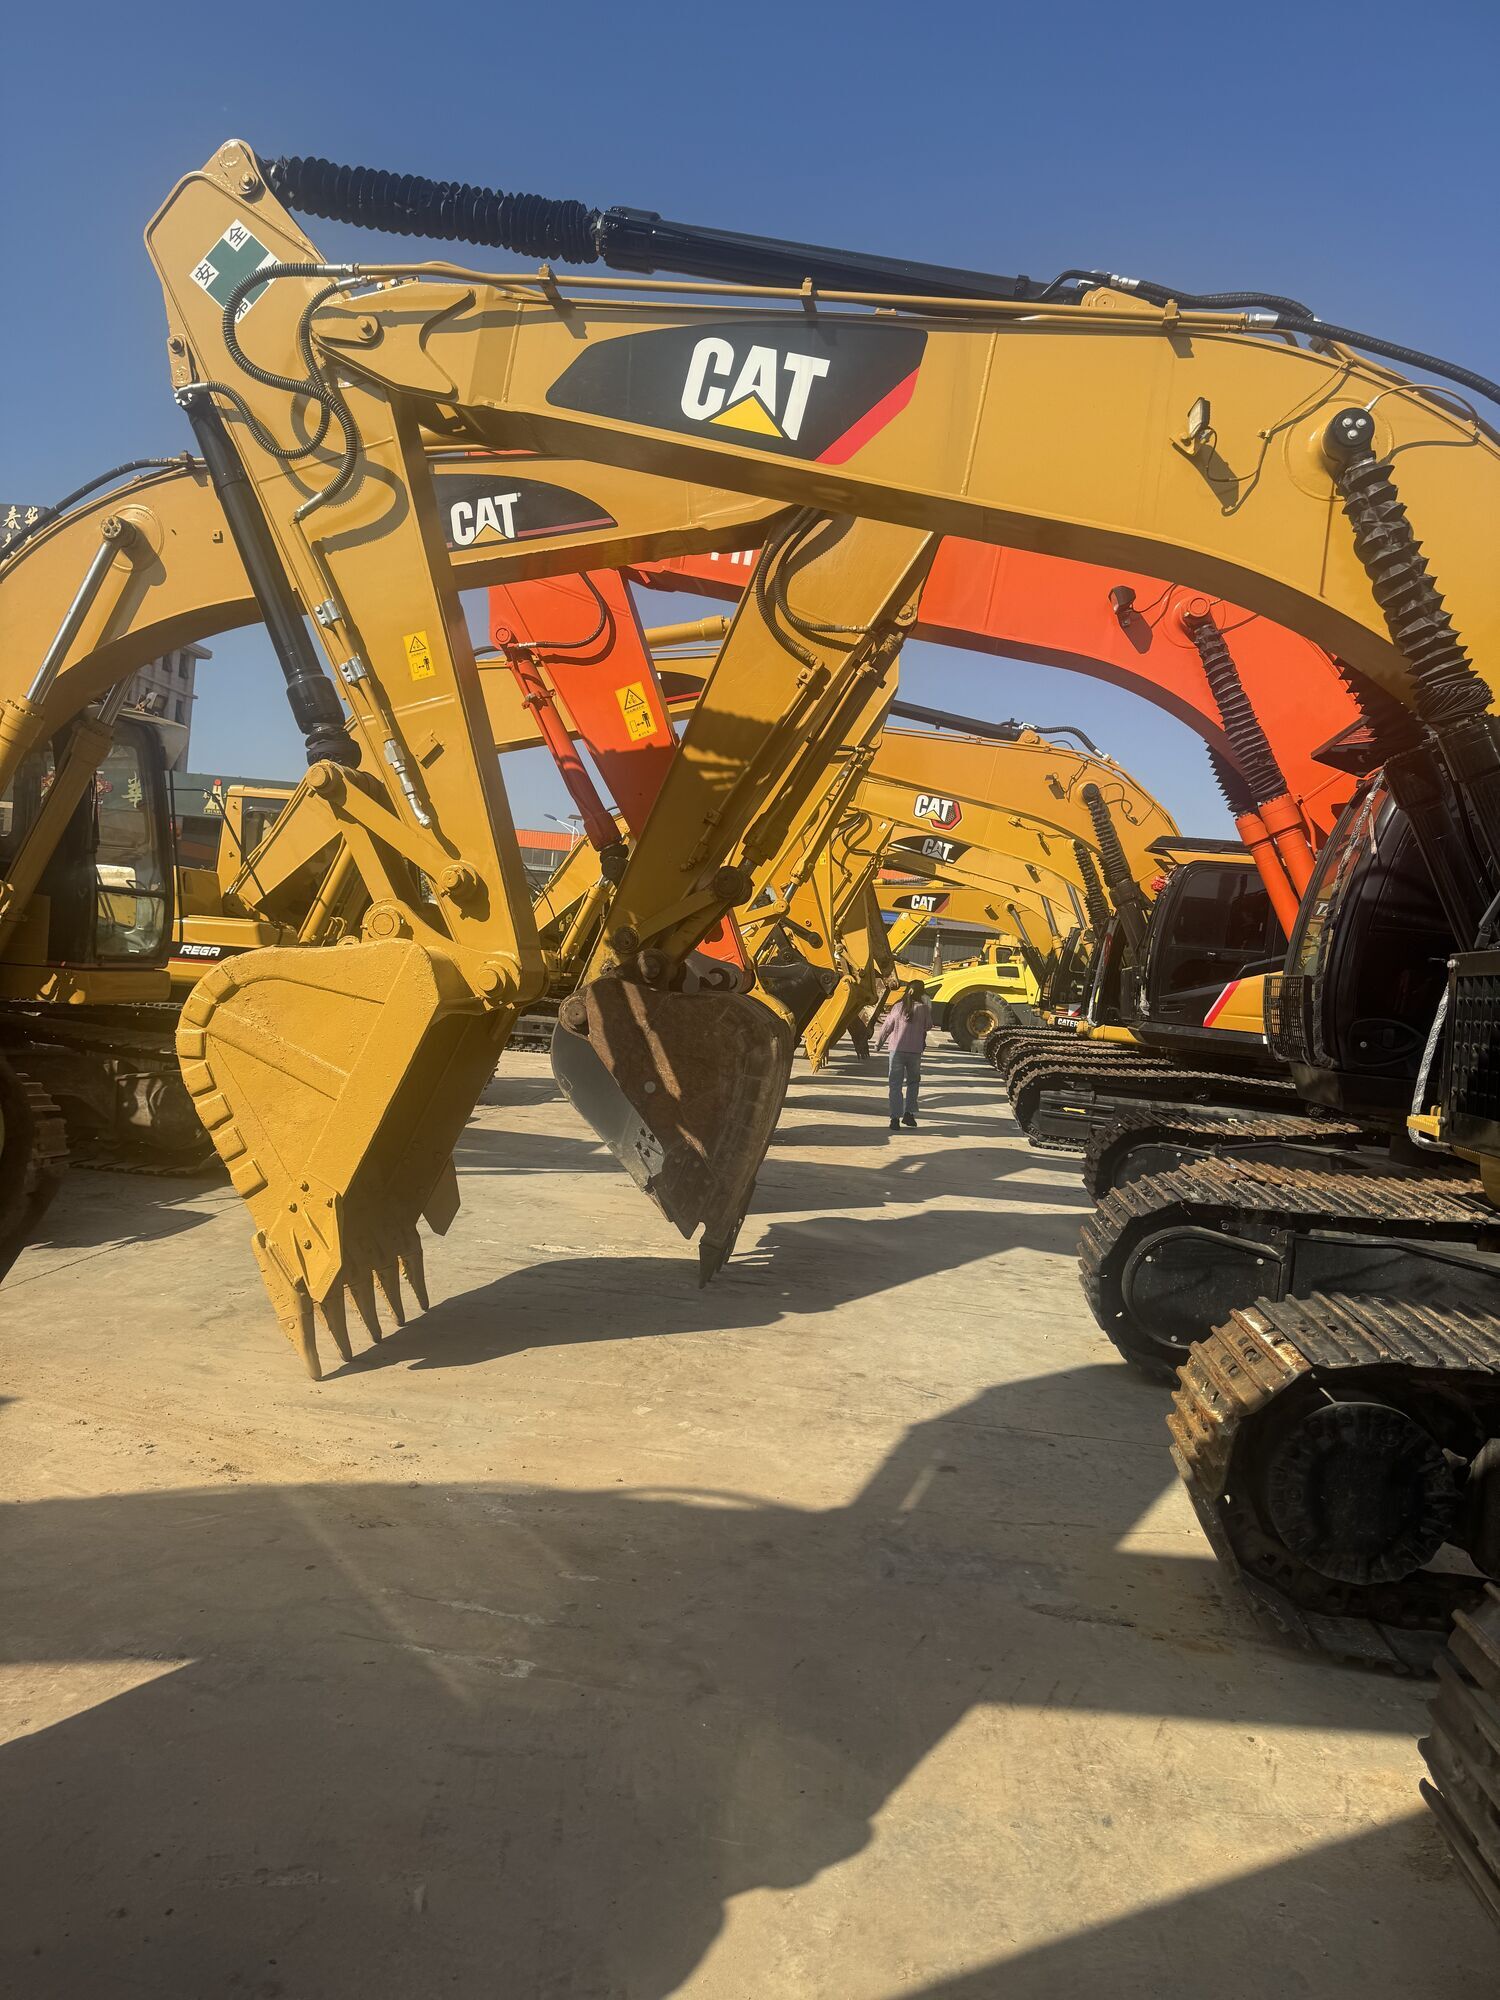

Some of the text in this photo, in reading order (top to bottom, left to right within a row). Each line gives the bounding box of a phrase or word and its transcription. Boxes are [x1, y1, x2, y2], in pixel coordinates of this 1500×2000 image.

[681, 337, 831, 441] CAT
[450, 492, 518, 546] CAT
[914, 794, 954, 822] CAT
[921, 838, 955, 861] CAT
[910, 895, 937, 912] CAT
[179, 944, 221, 957] REGA
